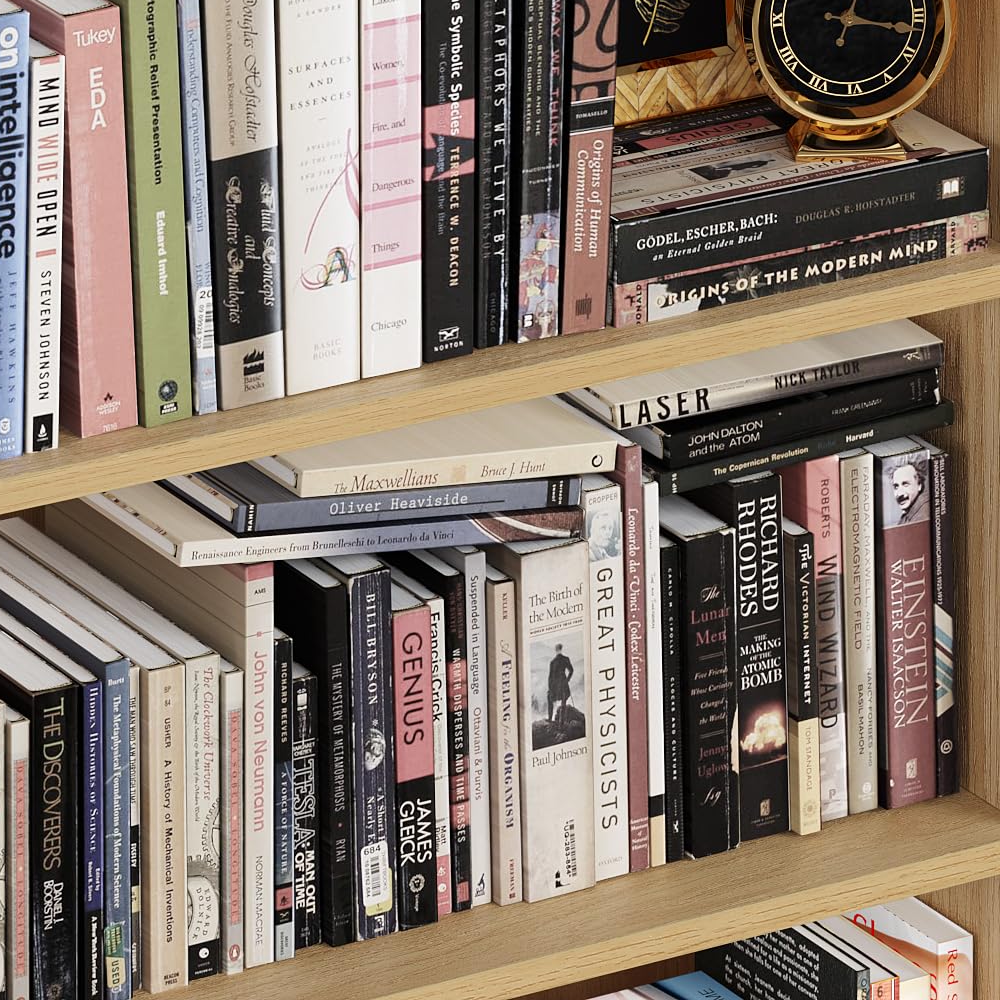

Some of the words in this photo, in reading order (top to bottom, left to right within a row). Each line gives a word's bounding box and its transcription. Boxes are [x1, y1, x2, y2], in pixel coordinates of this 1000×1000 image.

[0, 26, 20, 69] on
[73, 27, 117, 48] Tukey
[451, 15, 464, 79] Symbolic
[151, 64, 160, 102] Relief
[288, 56, 351, 74] SURFACES
[308, 77, 333, 89] AND
[38, 77, 59, 128] MIND
[290, 91, 352, 111] ESSENCES
[450, 83, 462, 135] Species
[37, 134, 59, 184] WIDE
[151, 105, 163, 185] Presentation
[588, 139, 604, 190] Origins
[37, 190, 57, 237] OPEN
[574, 150, 588, 253] Communication
[588, 194, 600, 203] of
[588, 209, 602, 257] Human
[637, 231, 684, 251] GÖDEL,
[686, 222, 738, 241] ESCHER,
[740, 213, 778, 232] BACH:
[735, 276, 759, 292] OF
[765, 267, 798, 286] THE
[804, 251, 883, 278] MODERN
[888, 238, 938, 263] MIND
[620, 387, 711, 428] LASER
[713, 466, 727, 476] The
[729, 455, 770, 473] Copernican
[771, 447, 809, 461] Revolution
[330, 497, 380, 515] Oliver
[390, 492, 468, 511] Heaviside
[191, 547, 244, 561] Renaissance
[246, 544, 286, 558] Engineers
[288, 541, 310, 553] from
[313, 536, 364, 551] Brunelleschi
[367, 538, 375, 547] to
[378, 533, 416, 546] Leonardo
[419, 532, 430, 542] da
[433, 530, 455, 541] Vinci
[738, 500, 759, 618] RHODES
[760, 493, 780, 611] RICHARD
[529, 595, 547, 607] The
[549, 588, 571, 603] Birth
[574, 584, 583, 596] of
[529, 610, 545, 623] the
[546, 603, 583, 619] Modern
[596, 568, 615, 653] GREAT
[253, 651, 267, 696] John
[402, 632, 424, 746] GENIUS
[253, 700, 265, 736] von
[599, 667, 618, 830] PHYSICISTS
[253, 739, 268, 832] Neumann
